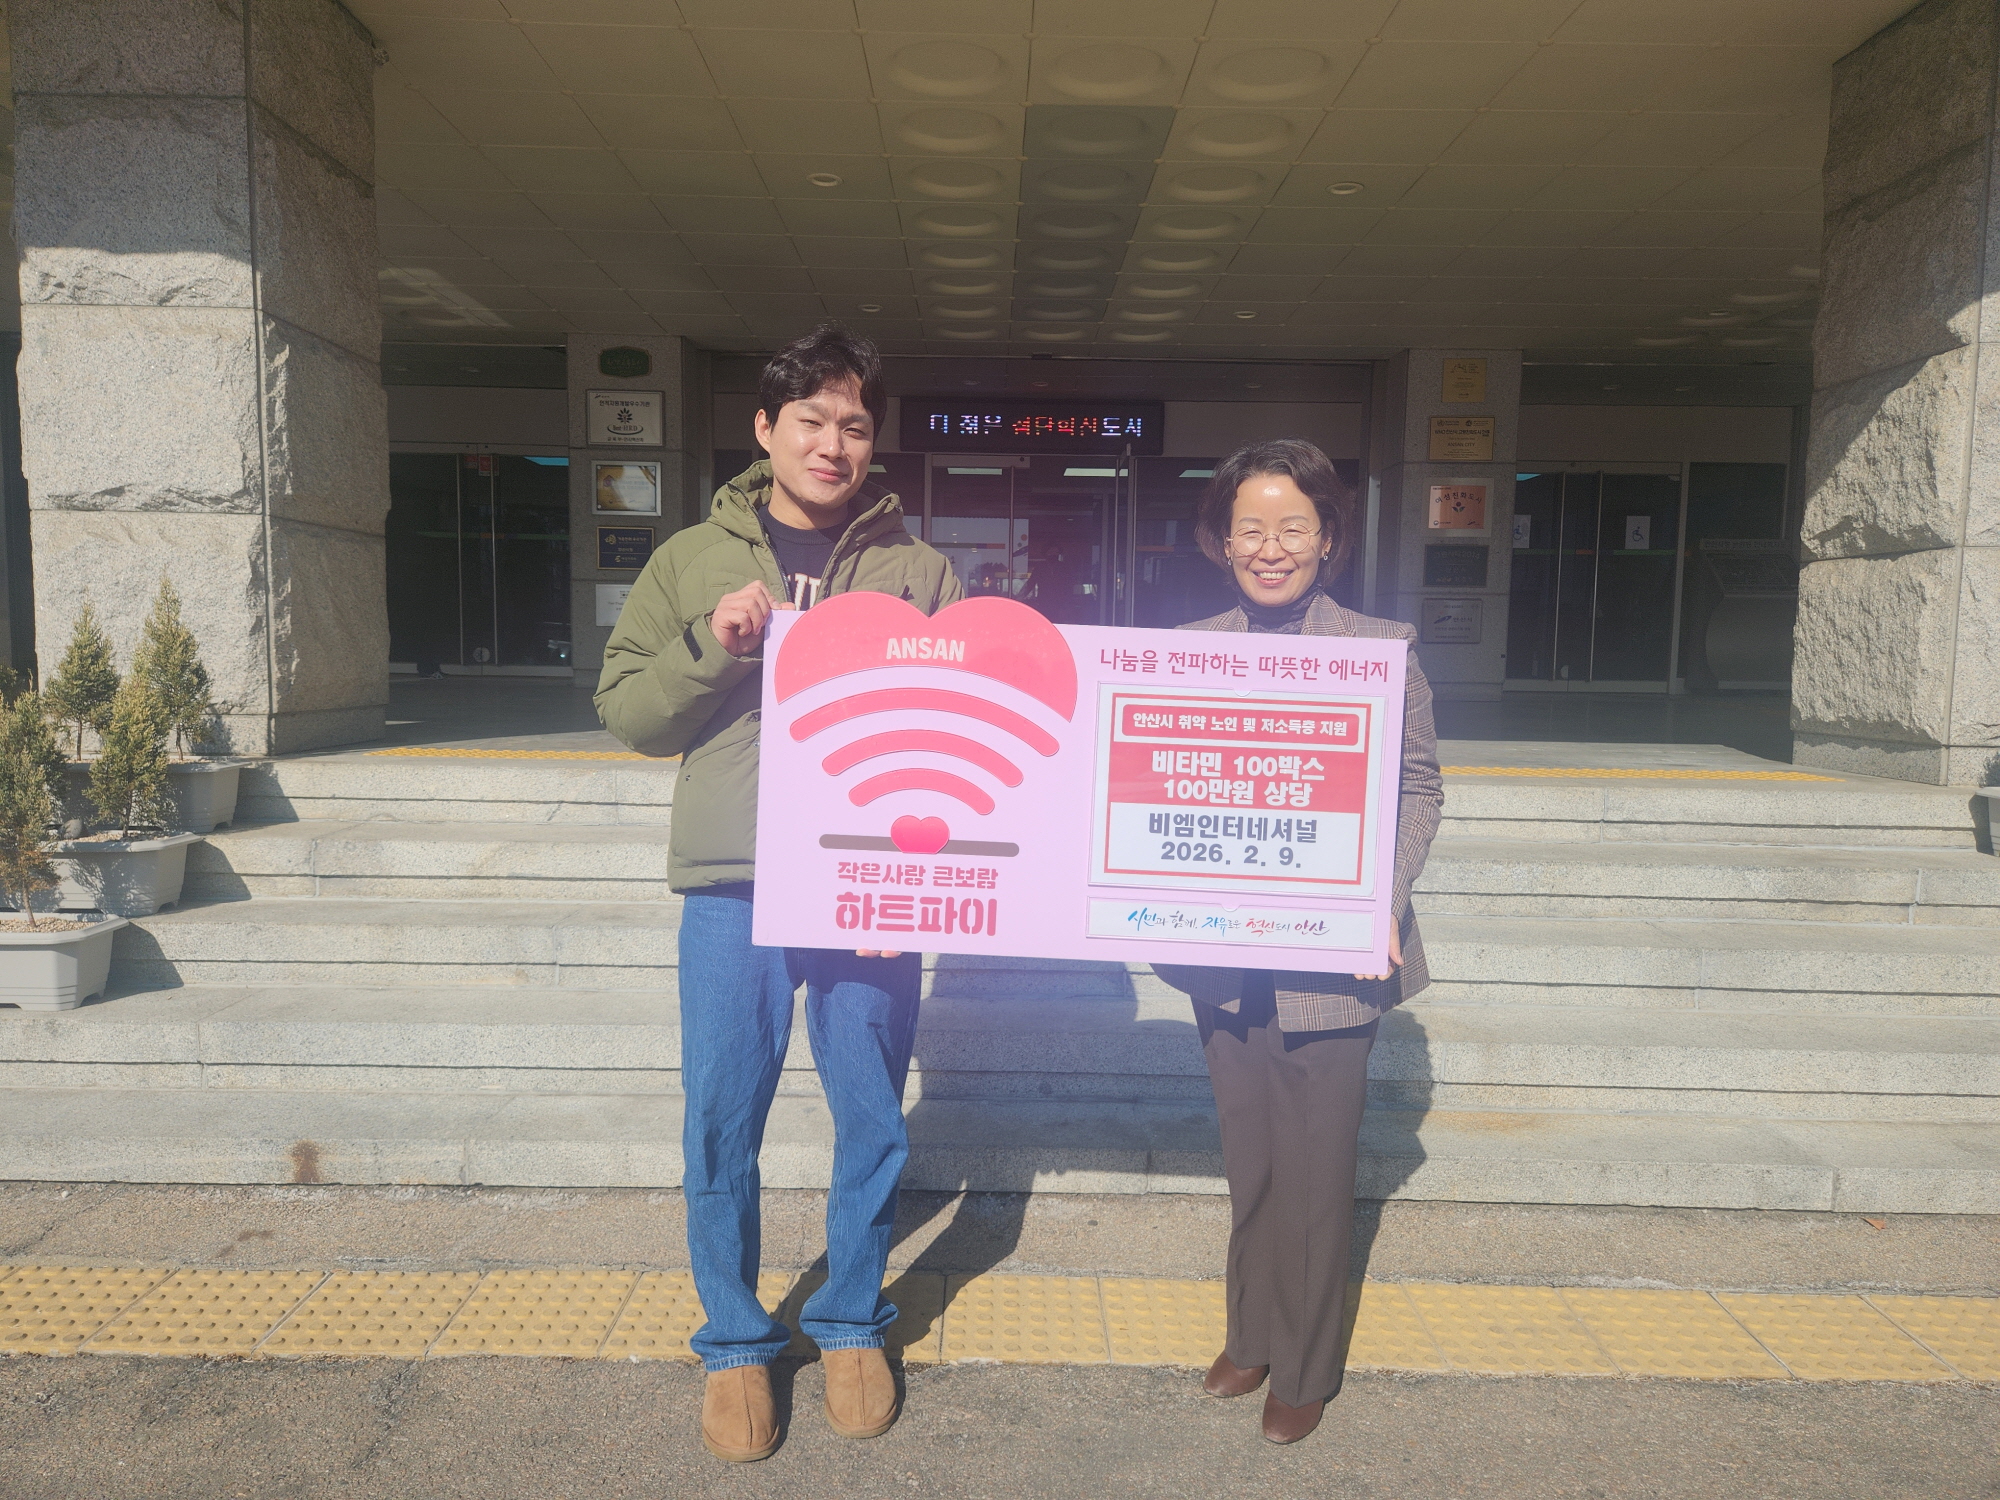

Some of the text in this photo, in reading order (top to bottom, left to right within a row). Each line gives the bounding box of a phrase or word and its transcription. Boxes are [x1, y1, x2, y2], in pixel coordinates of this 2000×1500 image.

[886, 637, 965, 663] ANSAN
[1100, 649, 1388, 682] 나눔을 전파하는 따뜻한 에너지
[1133, 712, 1347, 737] 안산시 취약 노인 및 저소득층 지원
[1152, 750, 1325, 781] 비타민 100박스
[1164, 779, 1312, 807] 100만원 상당
[1149, 812, 1317, 843] 비엠인터네셔널
[1161, 841, 1301, 868] 2026. 2. 9.
[838, 862, 998, 889] 작은사랑 큰보람
[836, 891, 997, 936] 하트파이
[1127, 907, 1168, 931] 시민과
[1201, 916, 1242, 937] 자유로운
[1246, 918, 1290, 936] 혁신도시
[1294, 919, 1330, 935] 안산
